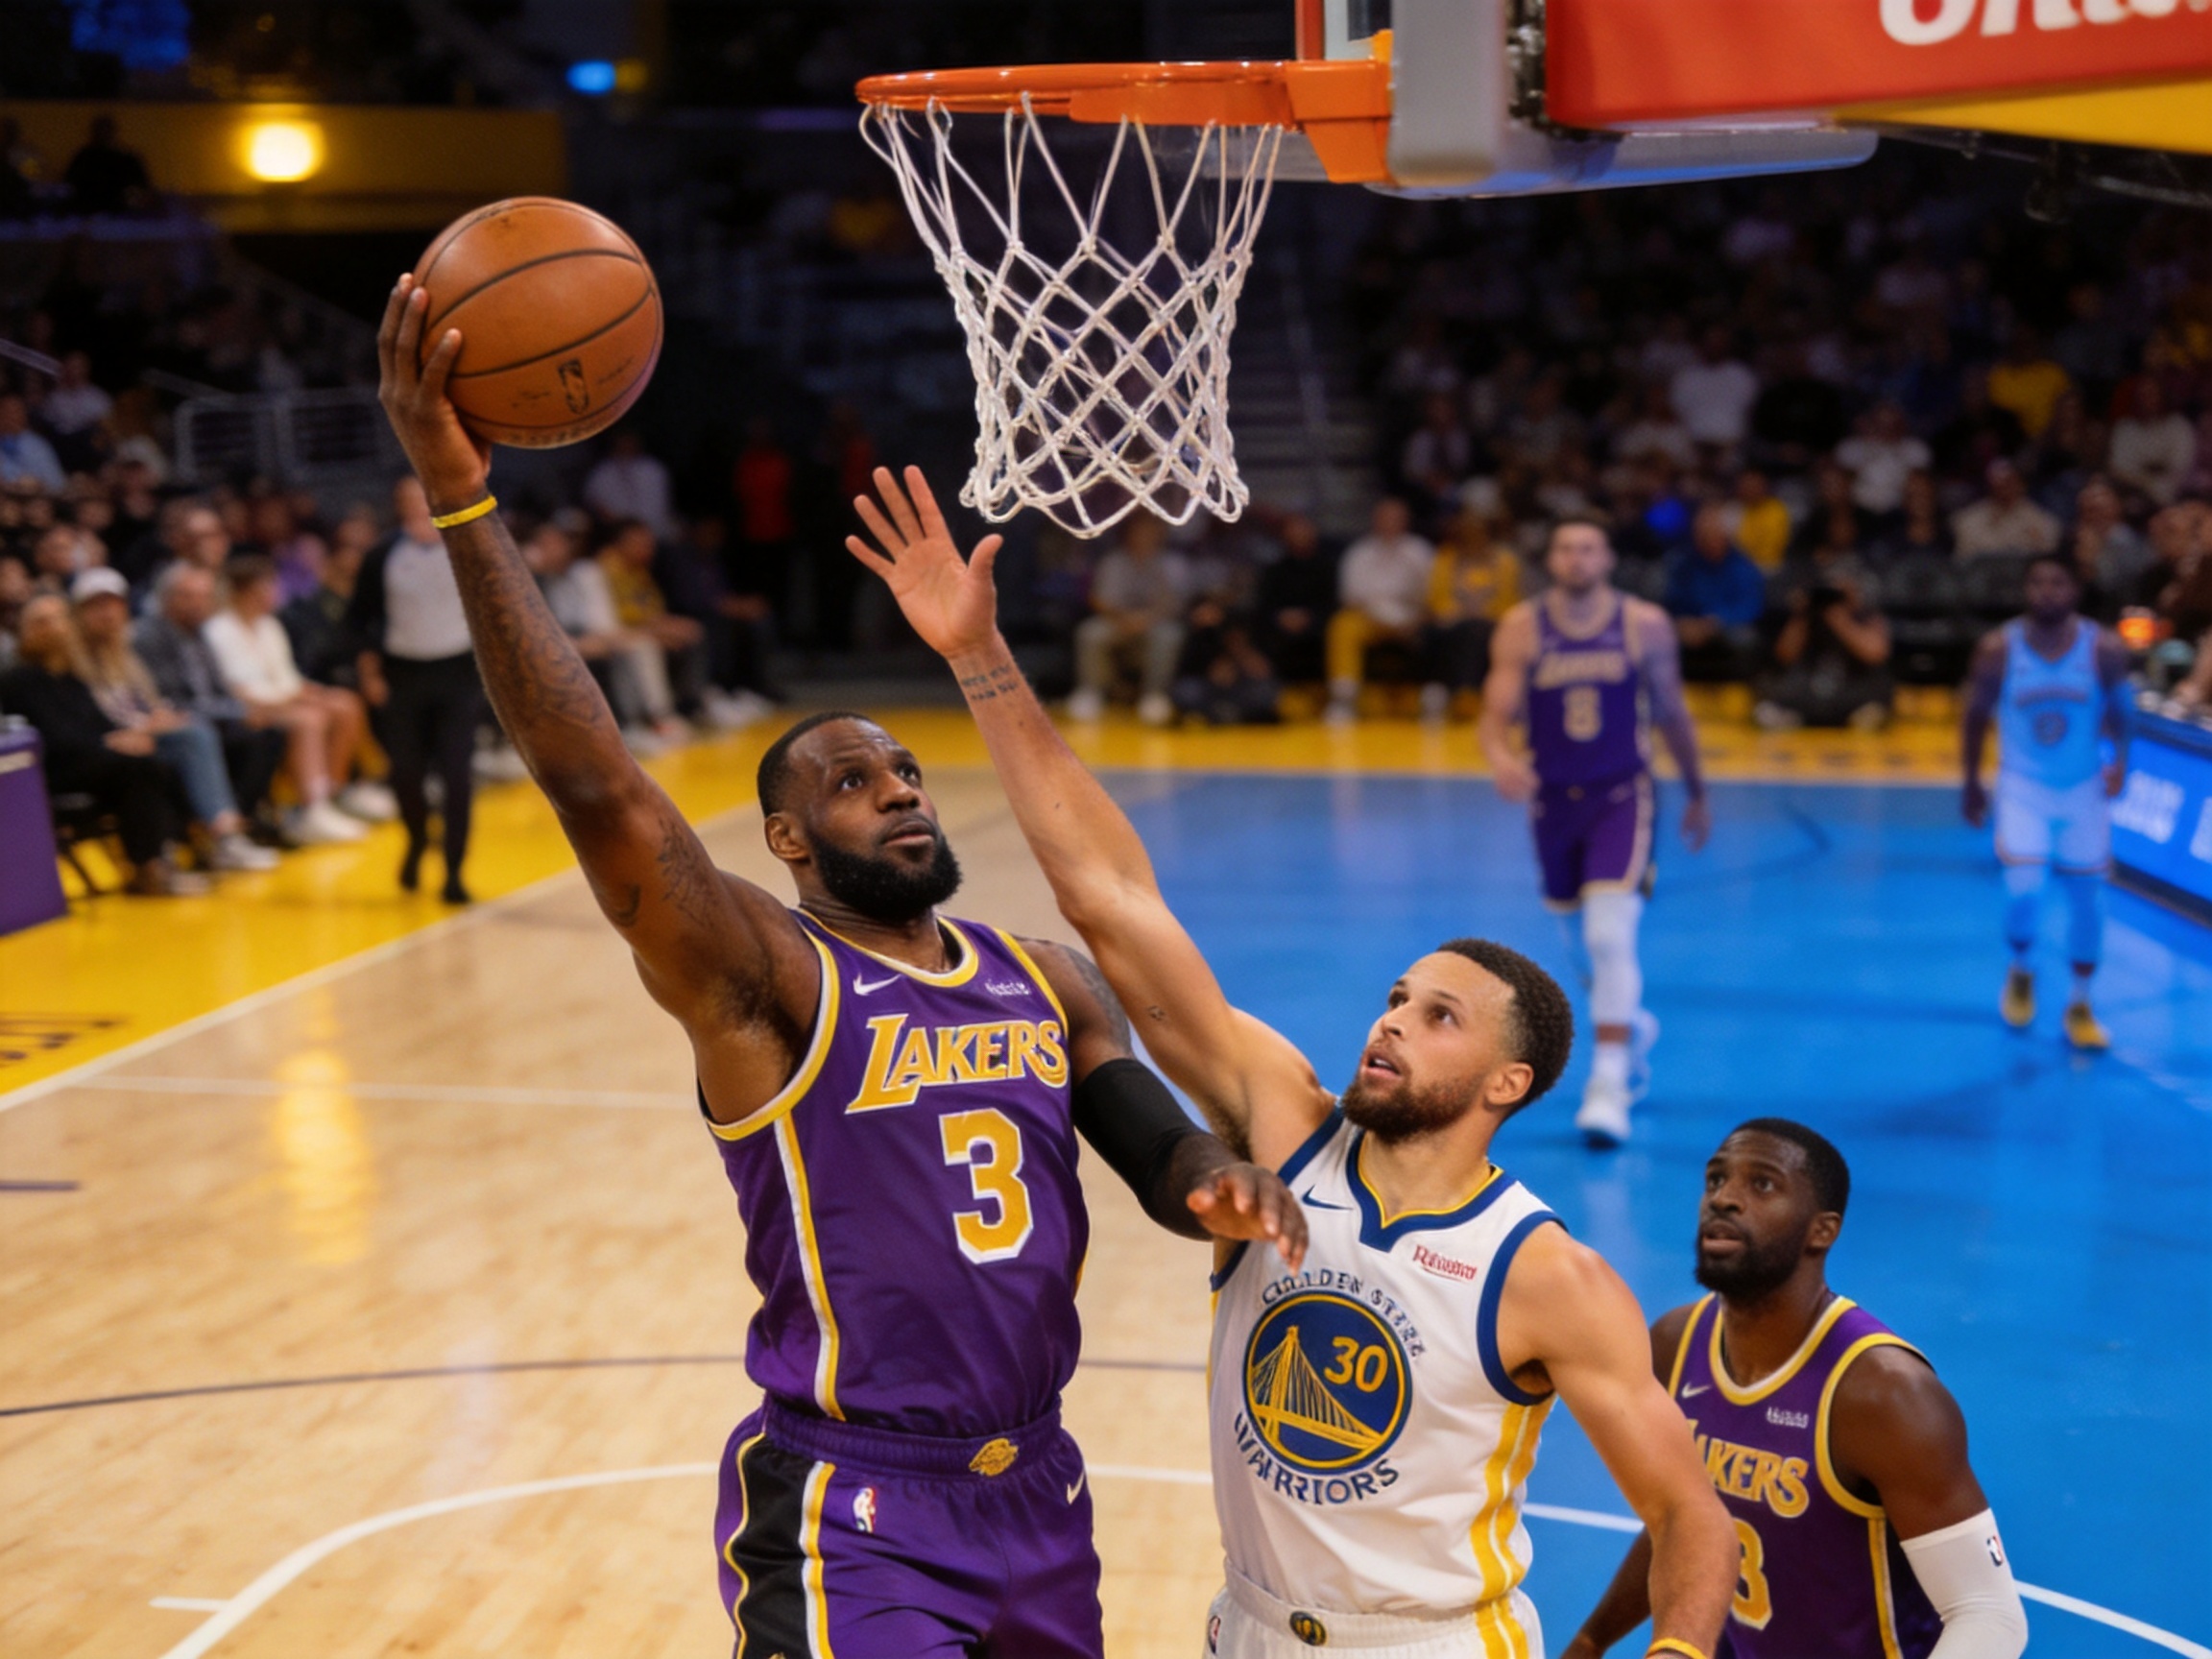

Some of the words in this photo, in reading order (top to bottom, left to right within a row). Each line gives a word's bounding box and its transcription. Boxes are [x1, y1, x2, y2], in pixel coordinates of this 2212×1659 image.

[845, 1013, 1069, 1114] LAKERS
[939, 1107, 1034, 1264] 3
[1324, 1335, 1388, 1392] 30
[1234, 1411, 1399, 1504] WARRIORS
